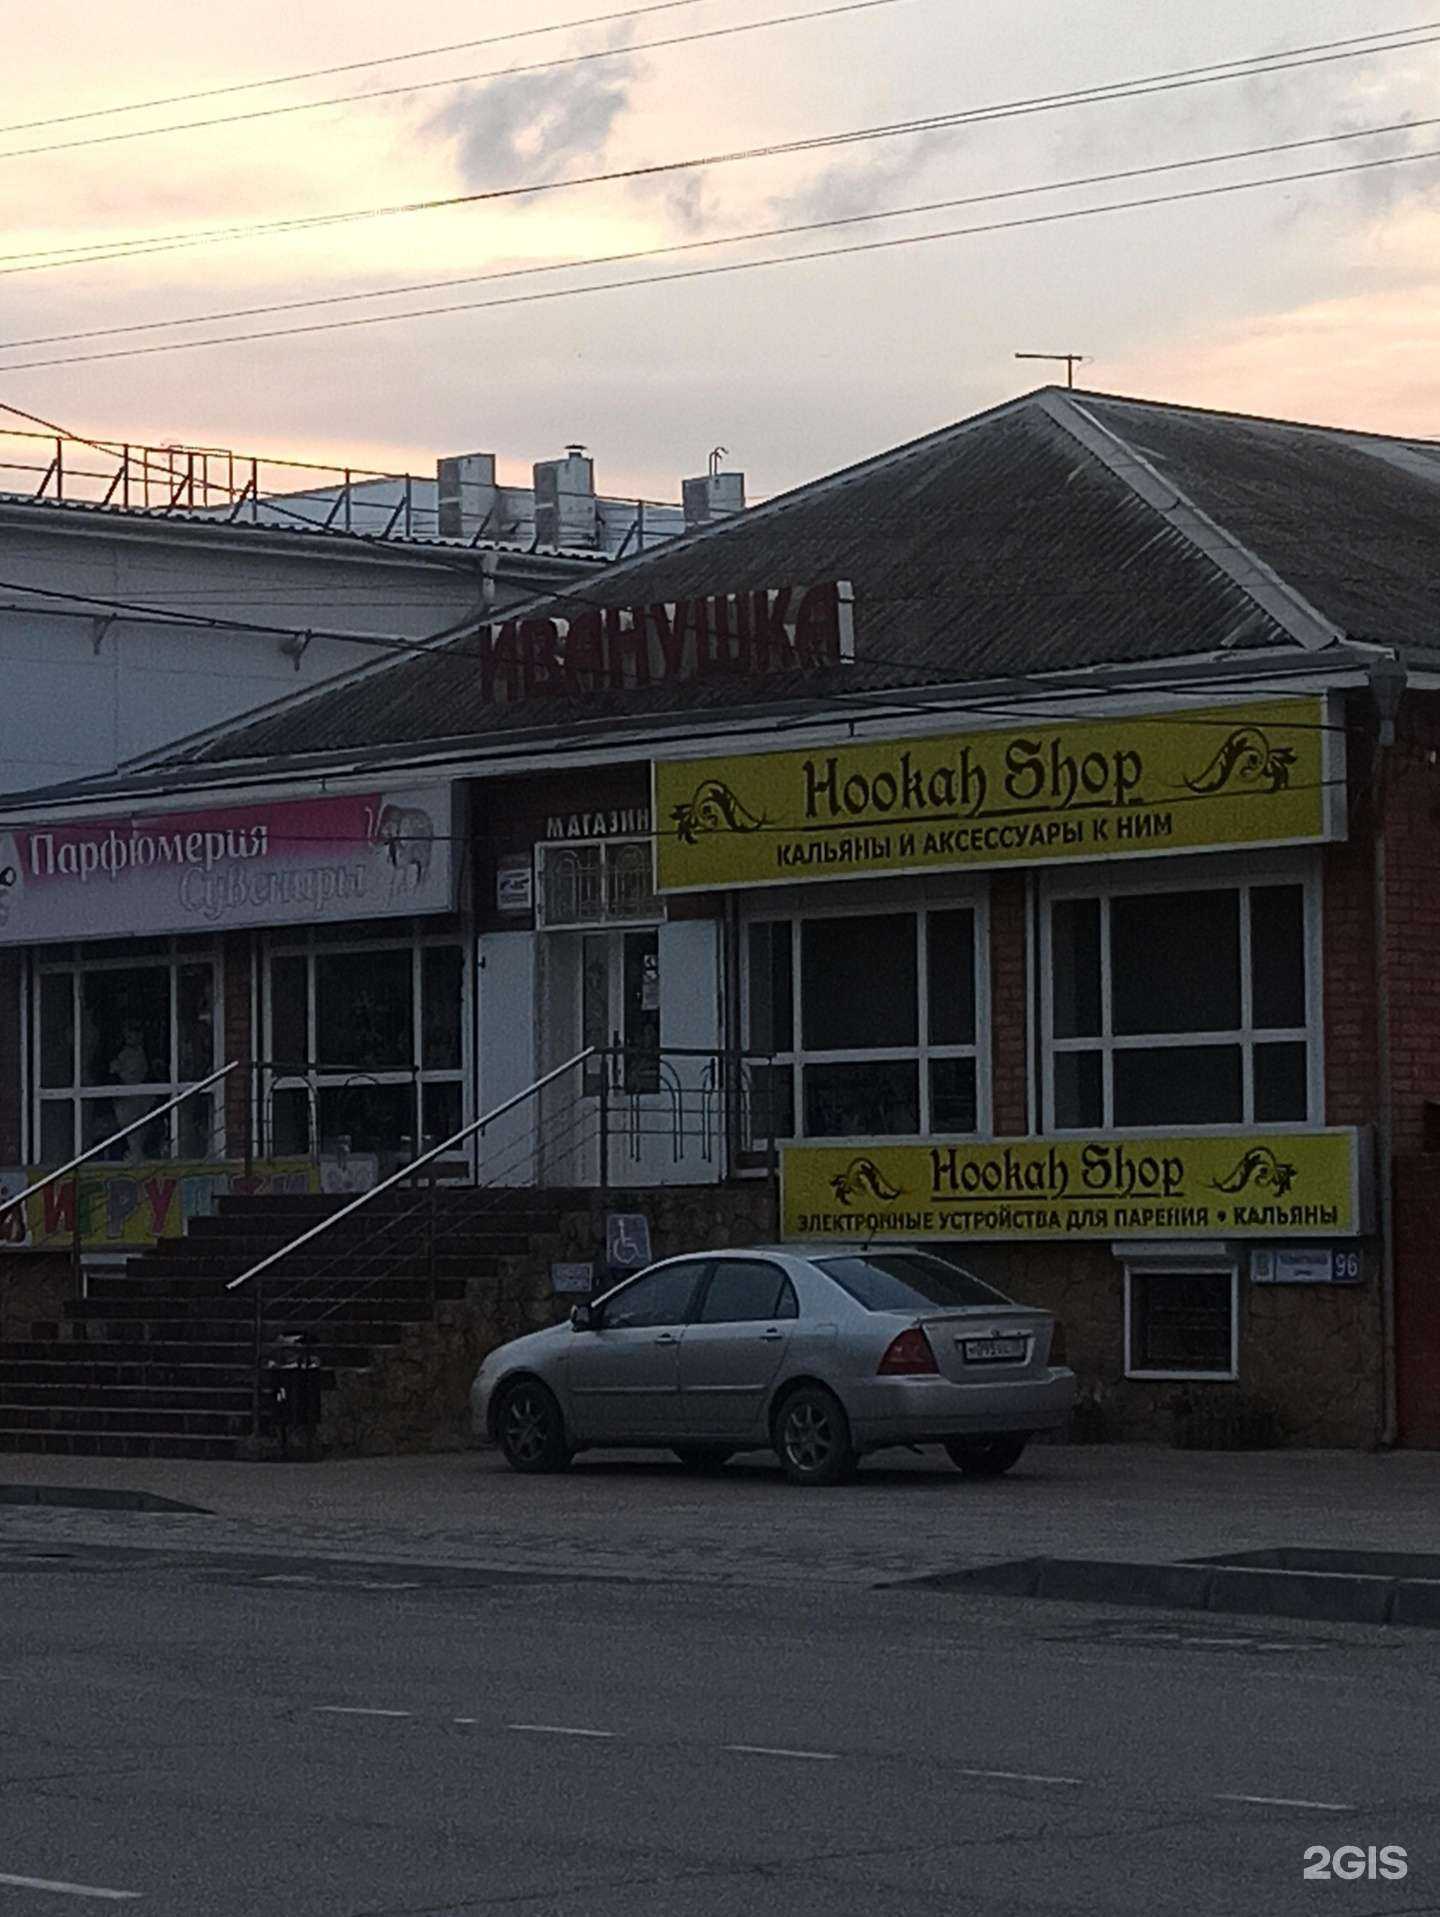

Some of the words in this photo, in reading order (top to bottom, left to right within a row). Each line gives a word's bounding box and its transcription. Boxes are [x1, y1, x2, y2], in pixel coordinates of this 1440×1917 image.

[481, 582, 855, 703] ИВАНУШКА
[804, 746, 986, 819] Hookah
[1004, 738, 1142, 810] Shop
[546, 809, 649, 838] МАГАЗИН
[778, 835, 890, 866] КАЛЬЯНЫ
[899, 832, 915, 856] И
[923, 820, 1084, 854] АКСЕССУАРЫ
[1093, 818, 1108, 841] К
[1116, 813, 1172, 838] НИМ
[29, 825, 268, 882] Парфюмерия
[179, 865, 368, 920] Сувениры
[931, 1149, 1068, 1198] Hookah
[1082, 1144, 1184, 1197] Shop
[798, 1210, 933, 1232] ЭЛЕКТРОННЫЕ
[939, 1206, 1062, 1231] УСТРОЙСТВА
[1067, 1208, 1108, 1231] ДЛЯ
[1115, 1207, 1209, 1228] ПАРЕНИЯ
[1234, 1204, 1338, 1227] КАЛЬЯНЫ
[1335, 1252, 1358, 1277] 96
